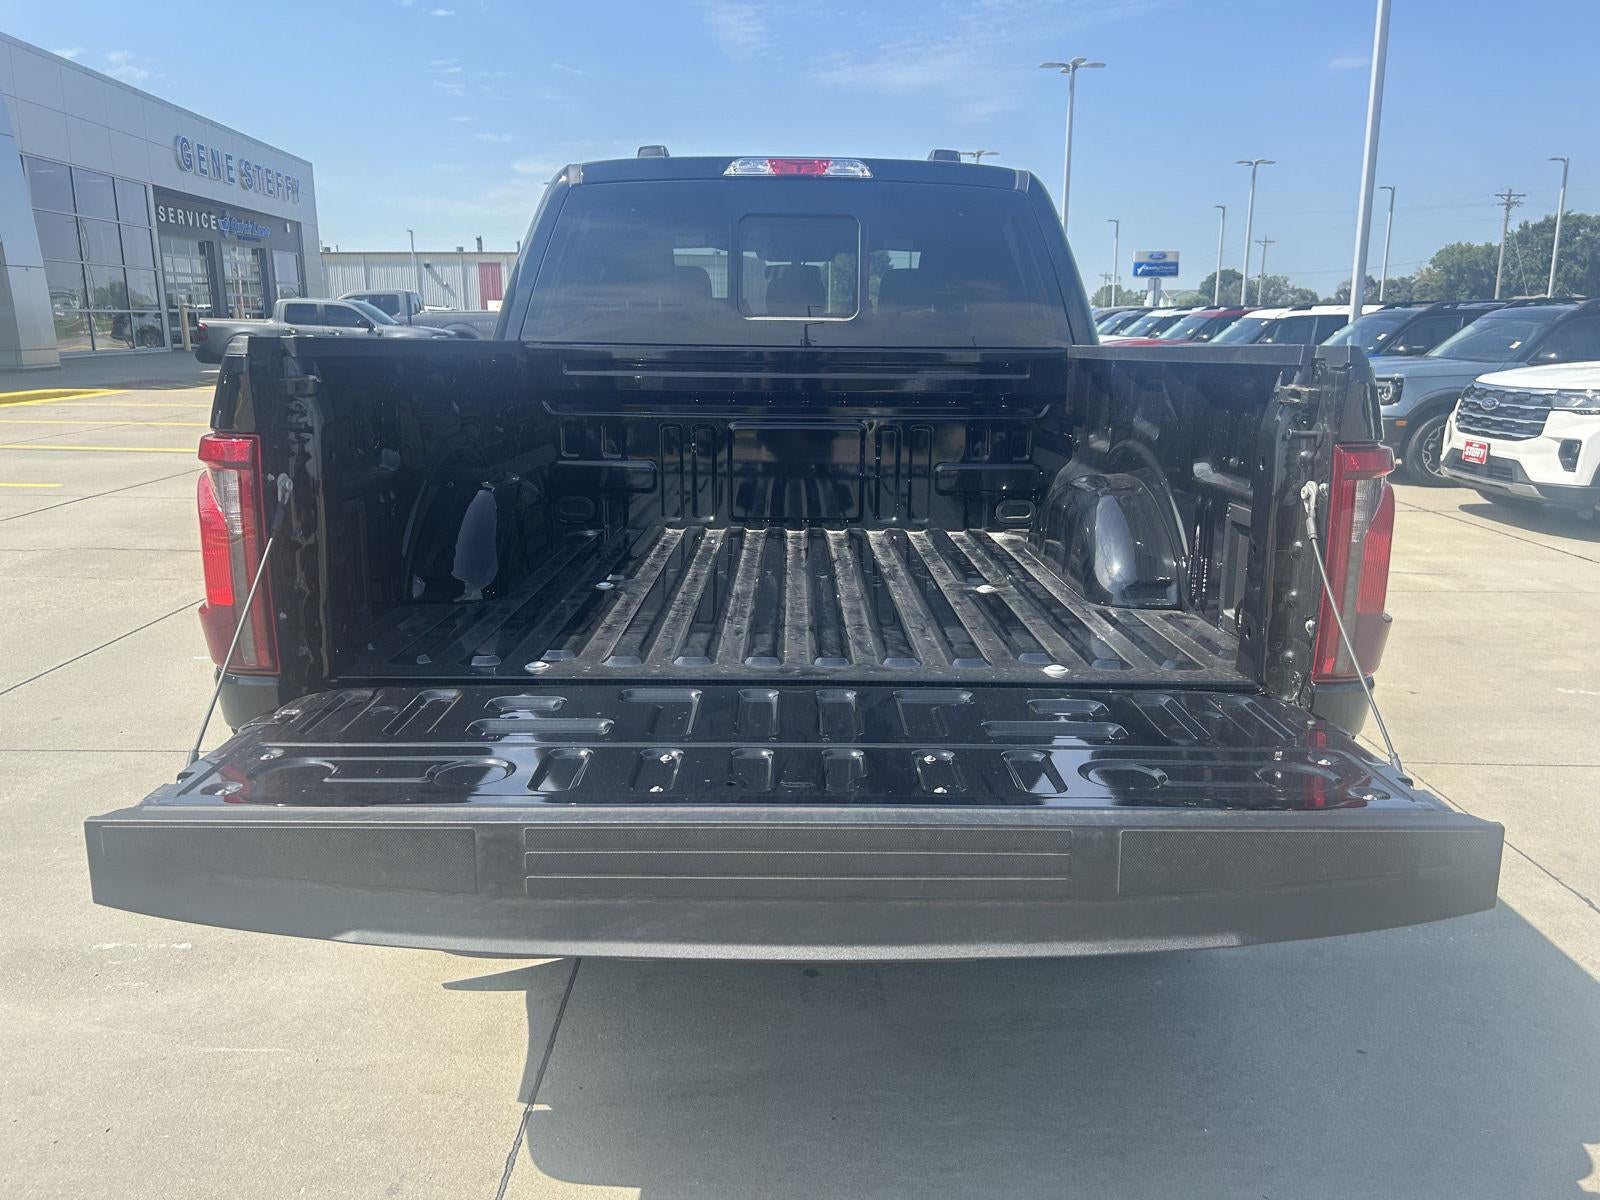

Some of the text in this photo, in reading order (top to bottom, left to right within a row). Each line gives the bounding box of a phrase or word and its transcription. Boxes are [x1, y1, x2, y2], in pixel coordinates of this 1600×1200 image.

[177, 135, 300, 203] GENE STEFFY
[158, 205, 217, 230] SERVICE
